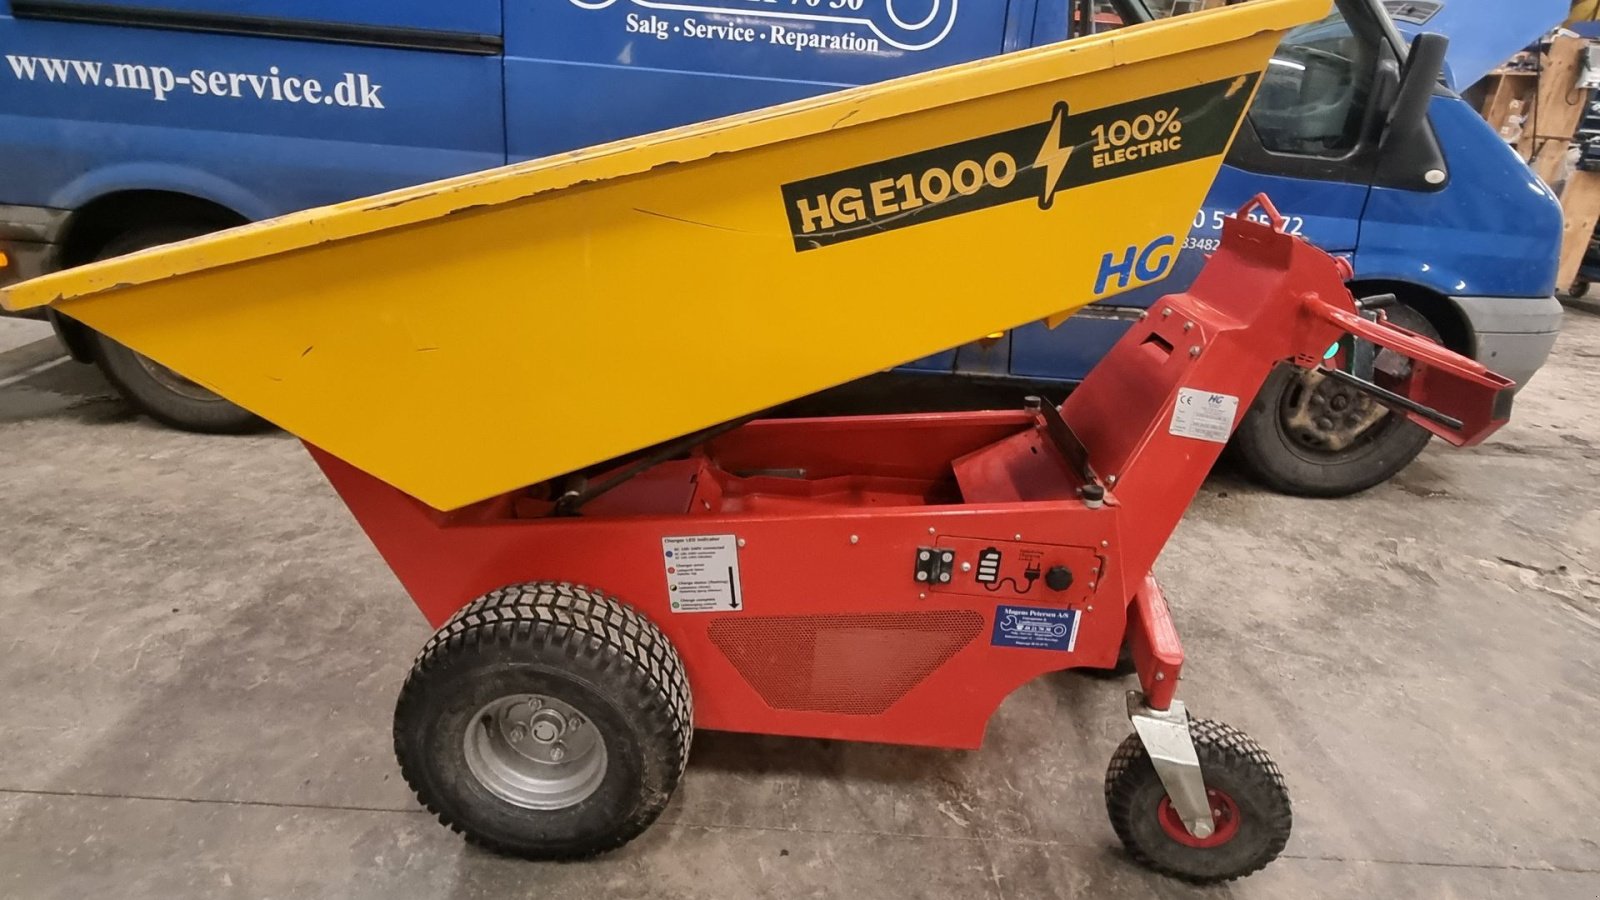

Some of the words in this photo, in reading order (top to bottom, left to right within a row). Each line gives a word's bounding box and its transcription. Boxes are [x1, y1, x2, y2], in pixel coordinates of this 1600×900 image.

[626, 13, 669, 39] Salg
[683, 18, 755, 42] Service
[769, 25, 879, 51] Reparation
[5, 54, 386, 109] www.mp-service.dk
[1091, 106, 1182, 152] 100%
[1092, 135, 1182, 168] ELECTRIC
[1093, 234, 1175, 294] HG
[1208, 394, 1224, 404] HG
